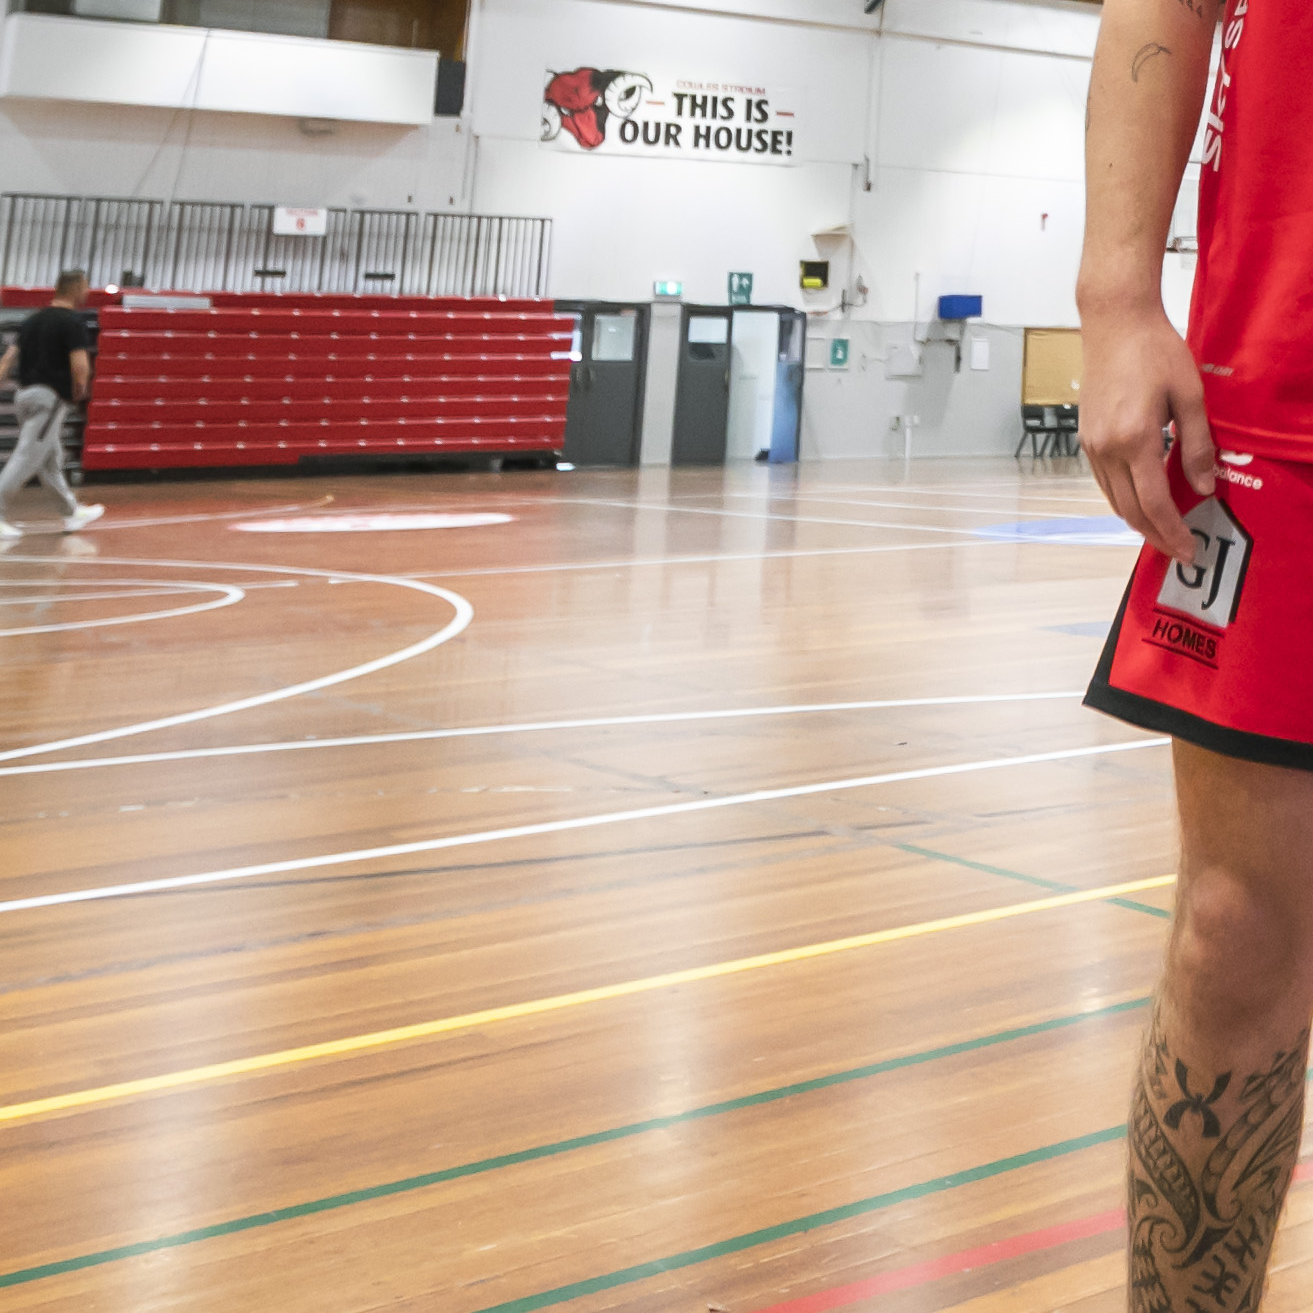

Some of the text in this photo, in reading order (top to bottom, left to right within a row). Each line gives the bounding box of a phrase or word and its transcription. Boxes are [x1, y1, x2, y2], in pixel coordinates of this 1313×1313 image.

[671, 92, 769, 124] THIS IS
[619, 119, 794, 156] OUR HOUSE!
[1175, 527, 1236, 611] GJ
[1151, 617, 1217, 659] HOMES
